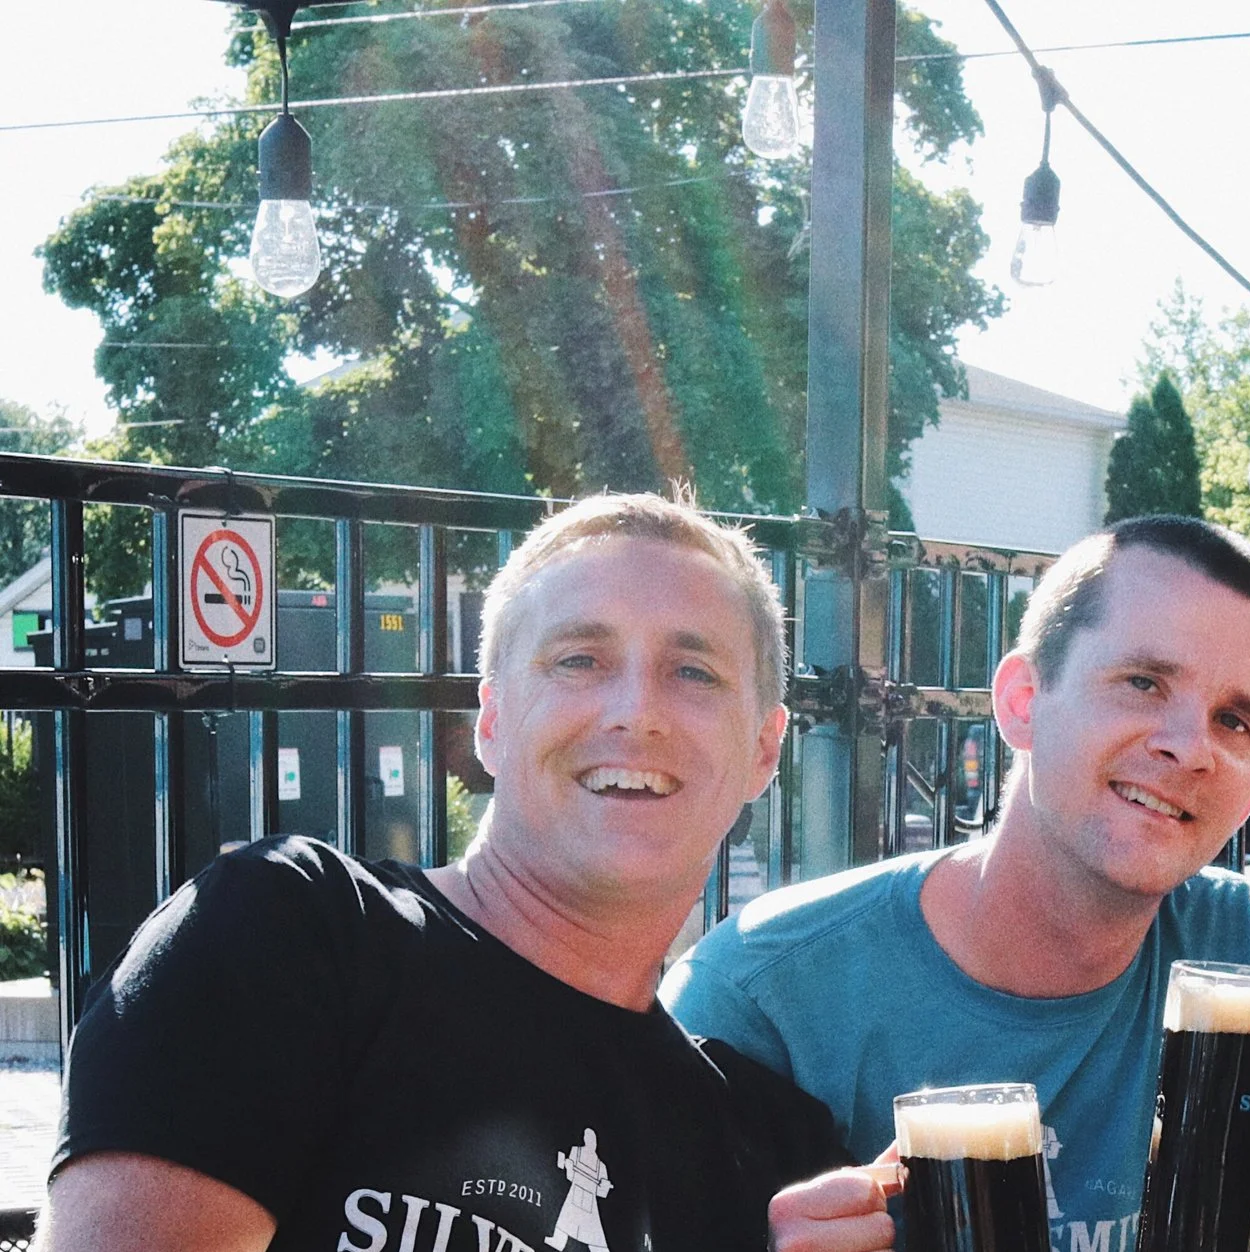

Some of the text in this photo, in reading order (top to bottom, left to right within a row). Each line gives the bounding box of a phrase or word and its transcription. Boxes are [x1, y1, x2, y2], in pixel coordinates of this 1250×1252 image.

[380, 614, 403, 631] 1551
[461, 1179, 541, 1207] ESTD 2011
